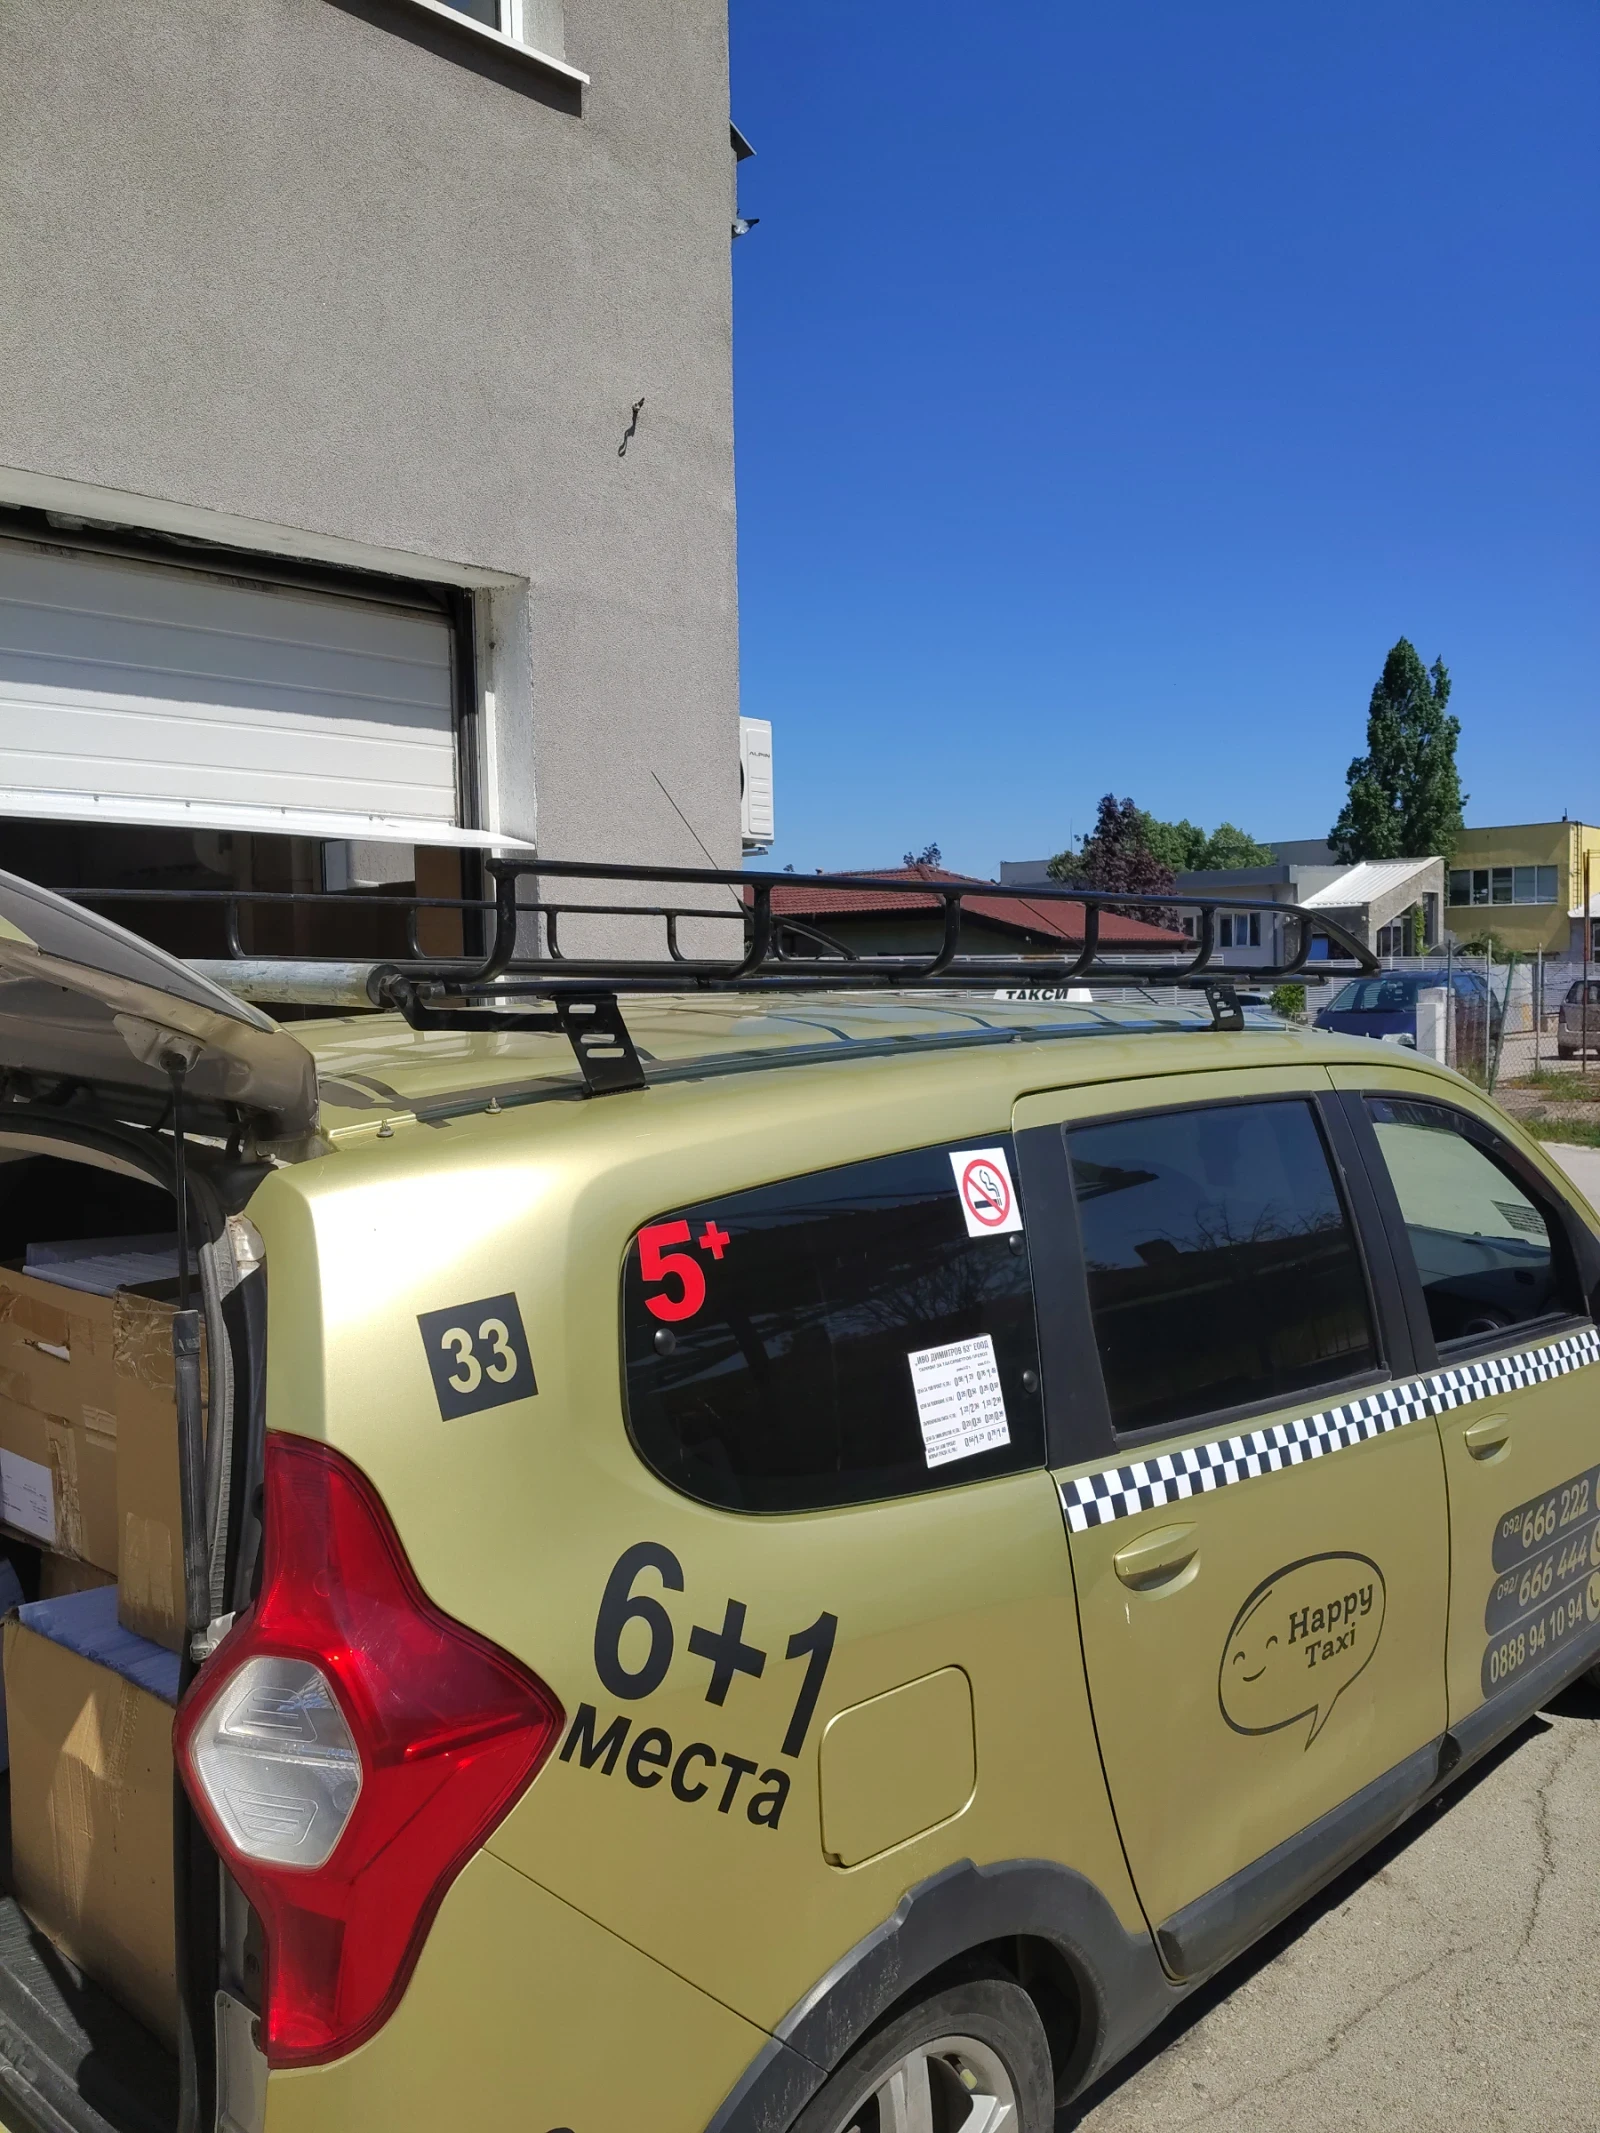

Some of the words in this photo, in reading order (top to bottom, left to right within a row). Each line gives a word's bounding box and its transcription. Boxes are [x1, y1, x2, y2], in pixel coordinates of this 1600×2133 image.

[1006, 989, 1068, 1000] ТАКСИ
[441, 1318, 518, 1394] 33
[1559, 1479, 1589, 1527] 222
[1518, 1555, 1553, 1607] 666
[1557, 1535, 1587, 1579] 444
[1288, 1584, 1373, 1645] Happy
[1305, 1622, 1356, 1669] Taxi
[1490, 1638, 1525, 1684] 0888
[1529, 1618, 1546, 1656] 94
[1550, 1605, 1564, 1642] 10
[1568, 1593, 1583, 1629] 94
[594, 1541, 838, 1759] 6+1
